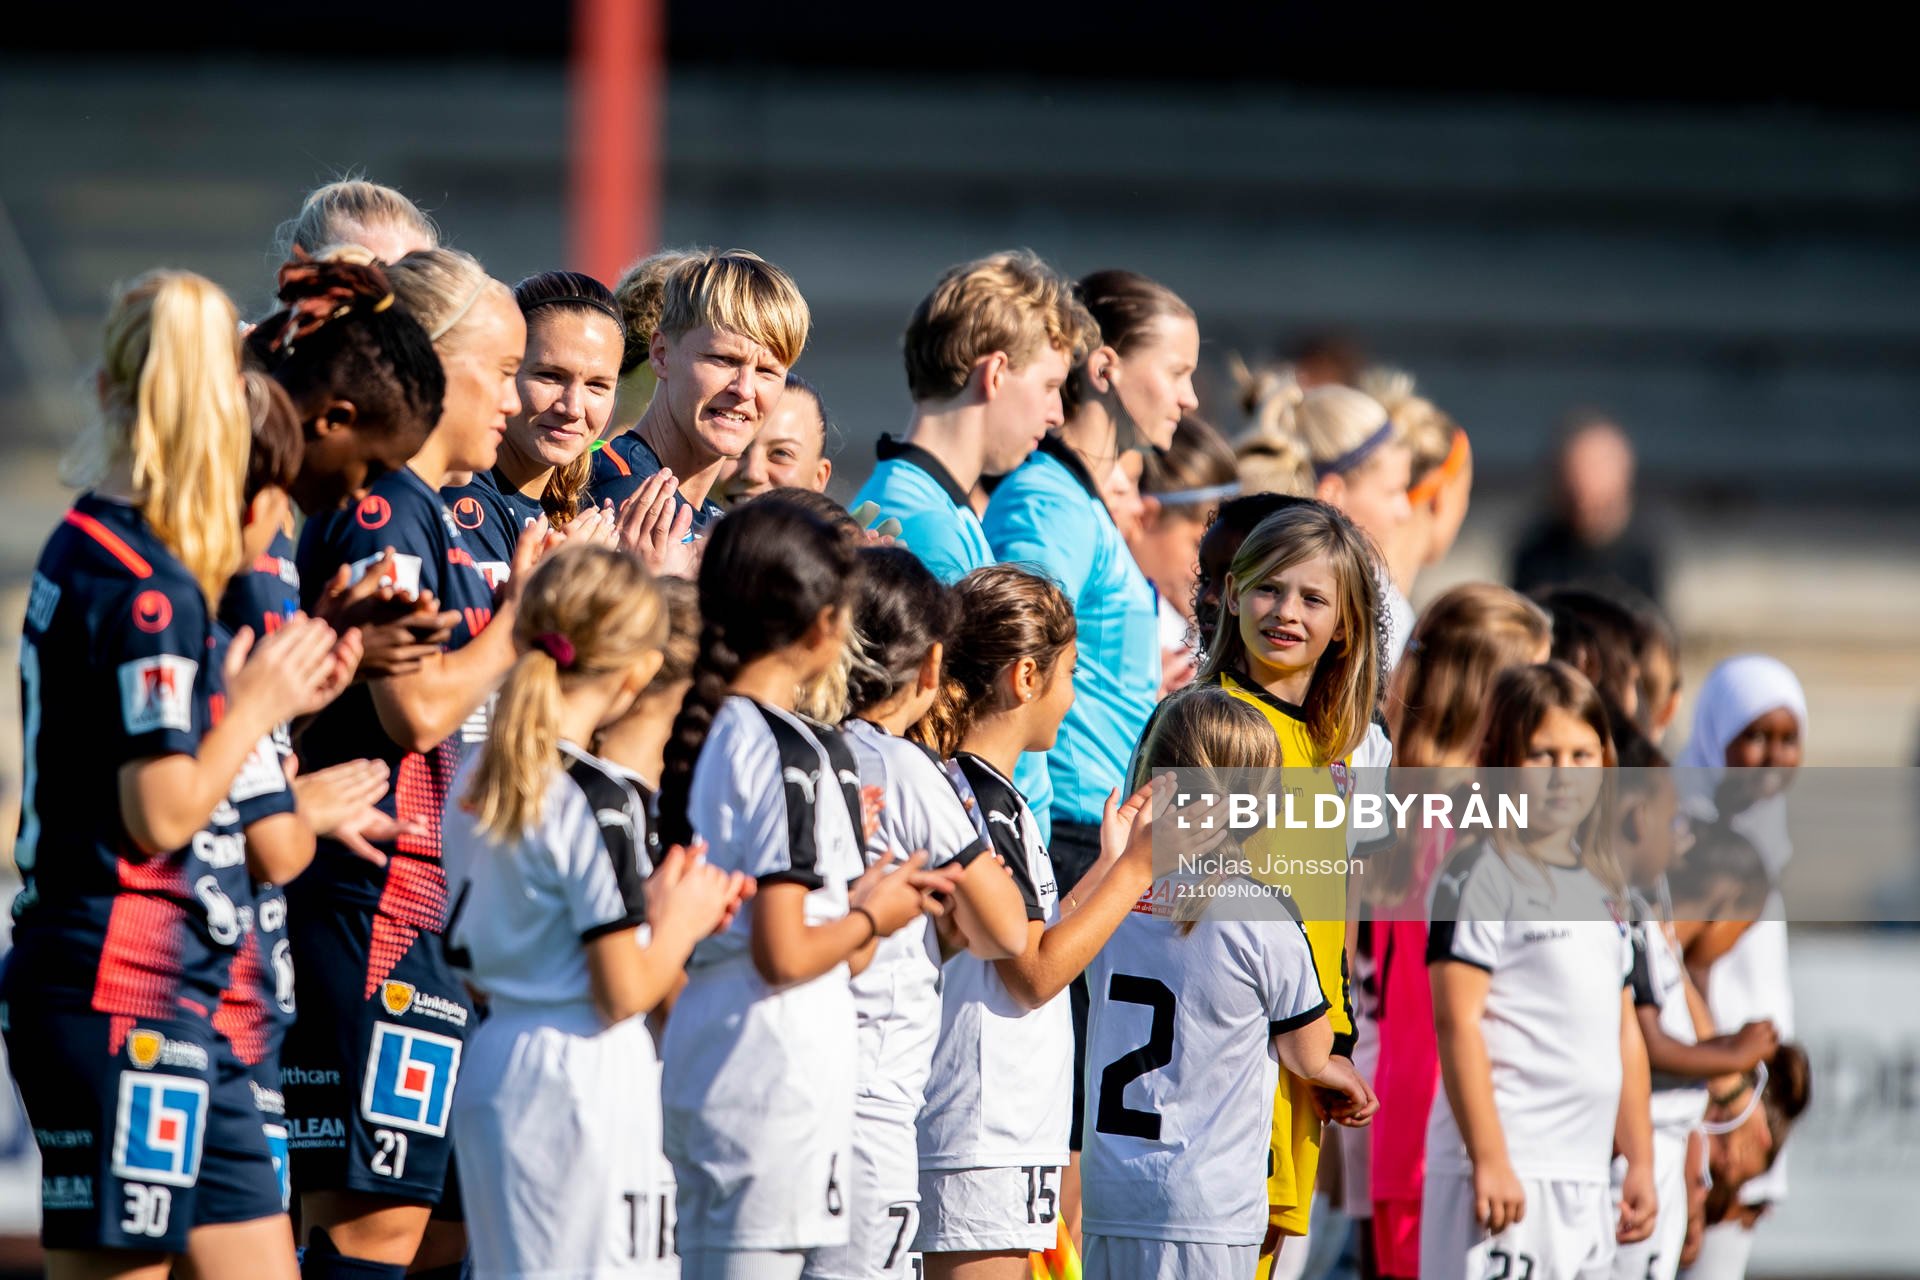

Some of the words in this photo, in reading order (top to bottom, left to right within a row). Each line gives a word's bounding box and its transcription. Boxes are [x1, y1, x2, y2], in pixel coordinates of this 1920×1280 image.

[1096, 973, 1177, 1141] 2
[371, 1129, 408, 1179] 21
[826, 1152, 843, 1217] 6
[121, 1182, 172, 1238] 30
[1021, 1166, 1056, 1224] 15
[883, 1206, 910, 1270] 7
